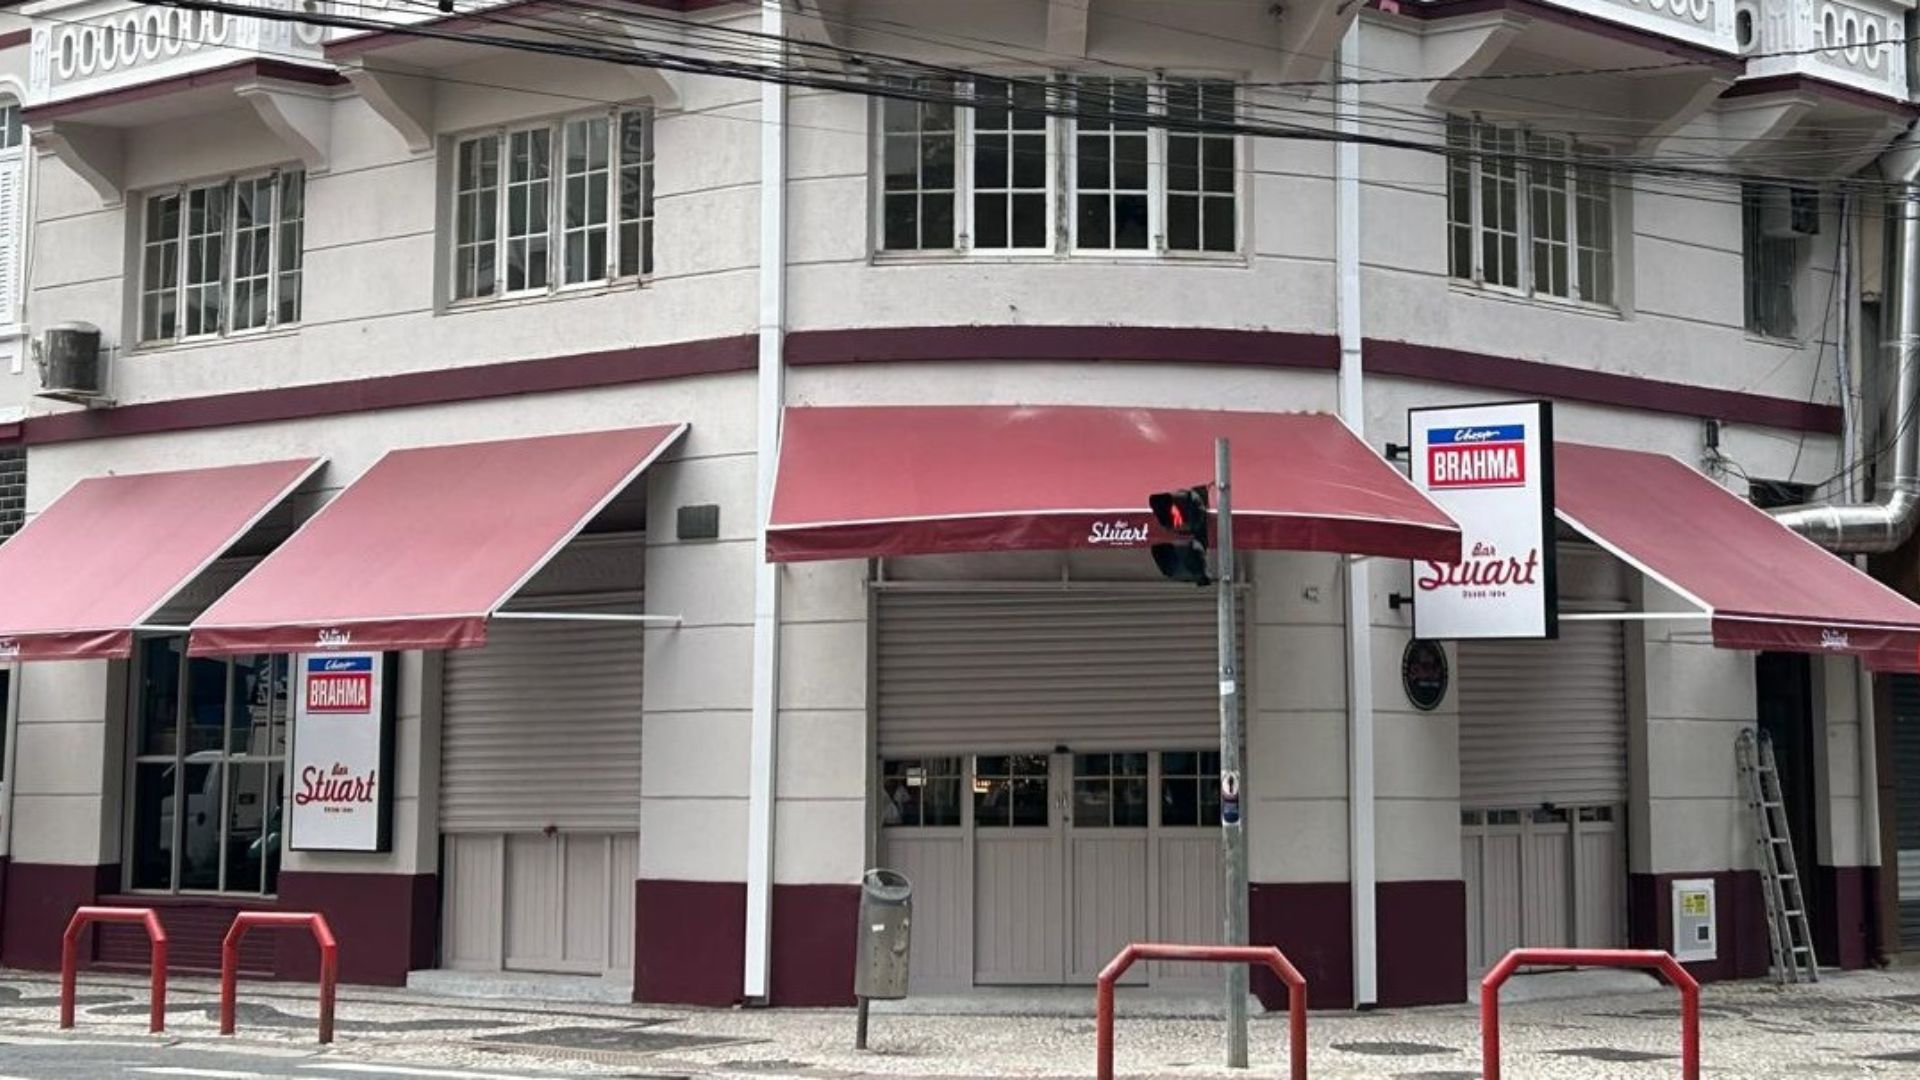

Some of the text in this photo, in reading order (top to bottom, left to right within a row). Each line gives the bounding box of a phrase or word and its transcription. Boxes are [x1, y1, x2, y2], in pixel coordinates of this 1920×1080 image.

[1433, 447, 1519, 481] BRAHMA
[1088, 521, 1148, 543] Stuart
[310, 677, 367, 706] BRAHMA
[295, 765, 376, 806] Stuart
